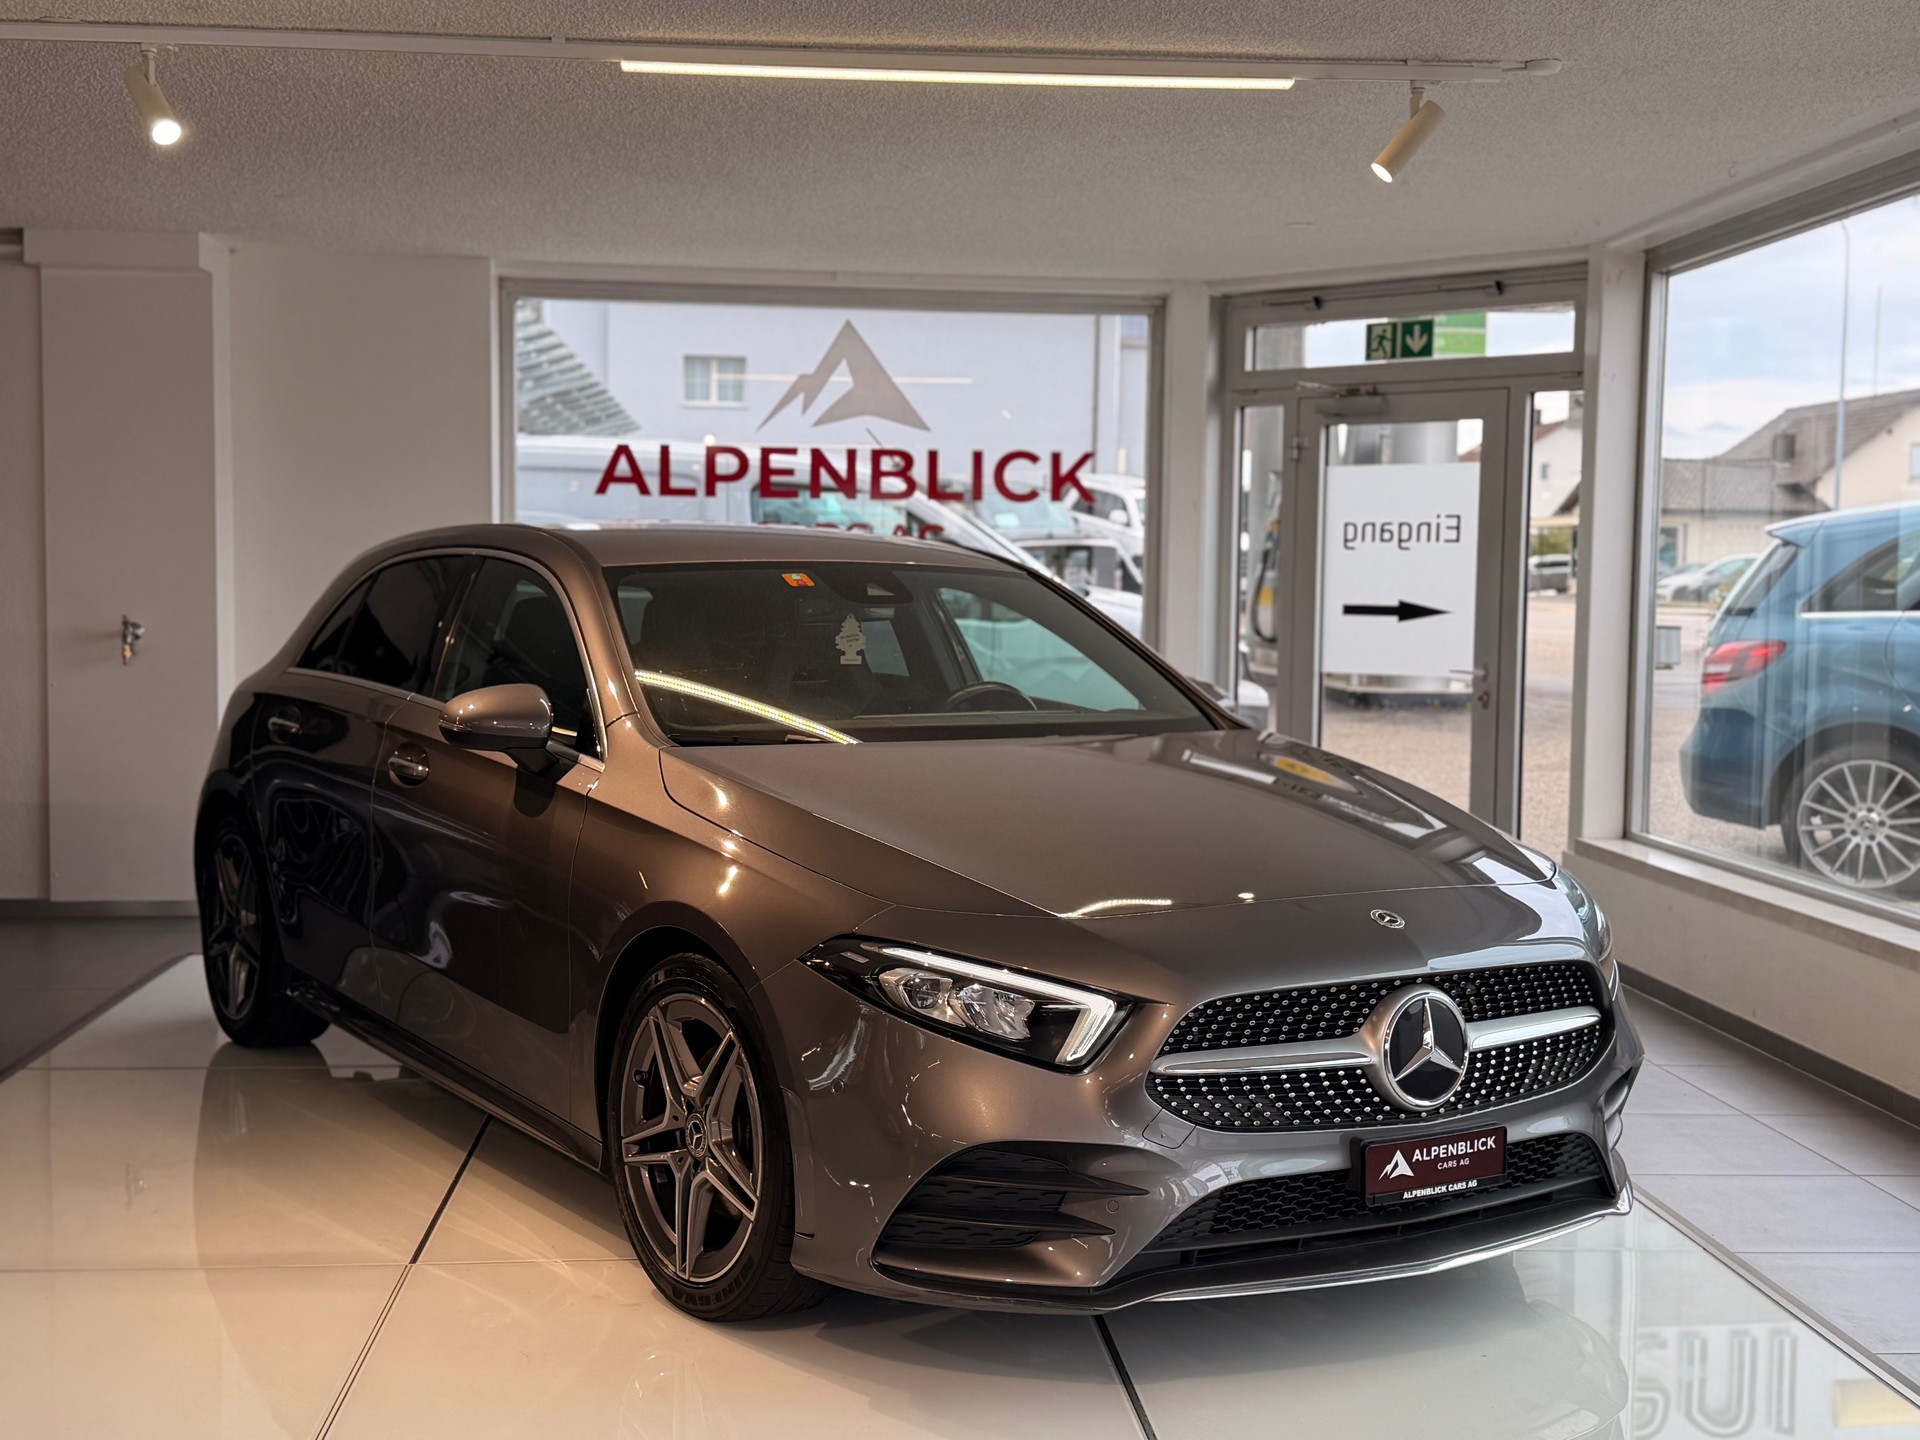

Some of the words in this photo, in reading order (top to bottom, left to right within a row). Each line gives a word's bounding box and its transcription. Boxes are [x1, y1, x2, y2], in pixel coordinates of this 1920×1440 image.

[595, 444, 1096, 503] ALPENBLICK
[1412, 1135, 1497, 1163] ALPENBLICK
[1437, 1159, 1458, 1170] CARS
[1459, 1157, 1470, 1167] AG
[1402, 1184, 1448, 1200] ALPENBLICK
[1448, 1181, 1467, 1193] CARS
[1468, 1179, 1478, 1189] AG
